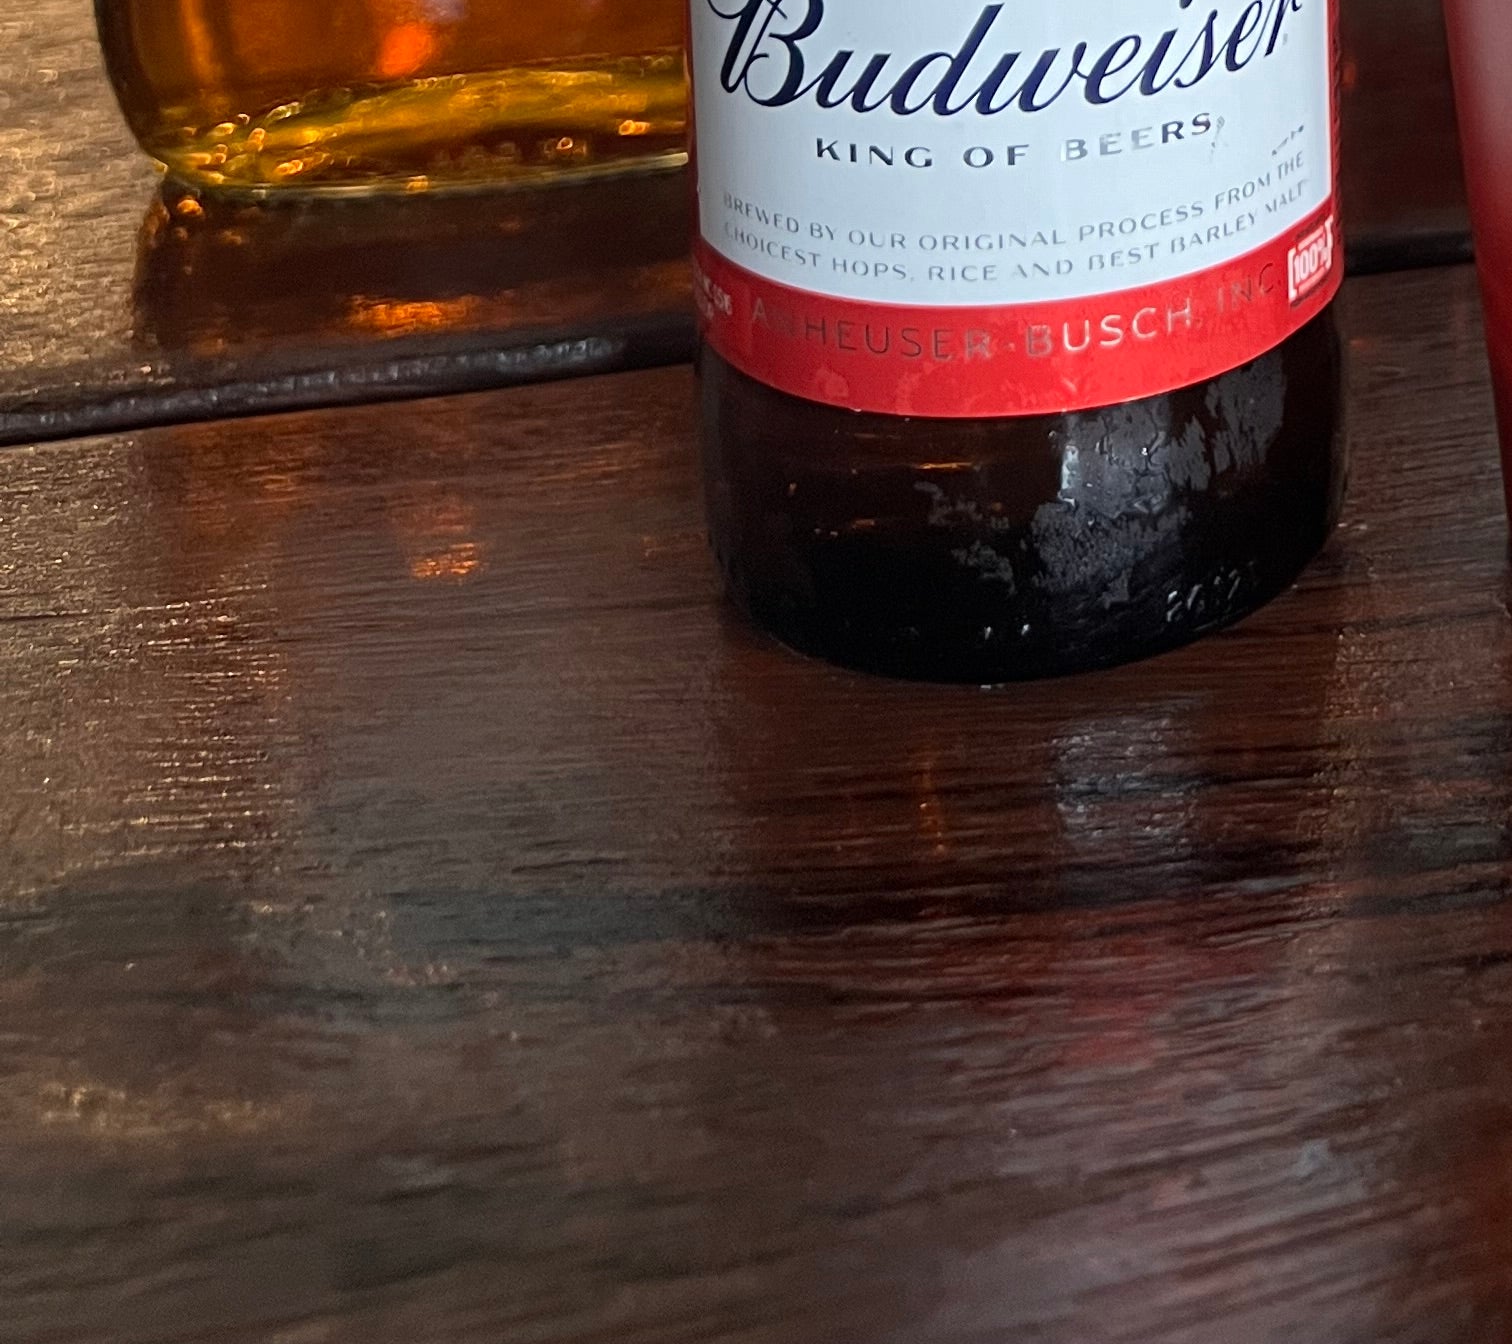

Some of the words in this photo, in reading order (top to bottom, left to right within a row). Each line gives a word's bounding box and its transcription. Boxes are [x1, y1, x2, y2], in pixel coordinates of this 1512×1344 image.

[722, 192, 799, 233] BREWED
[809, 222, 837, 241] BY
[849, 229, 906, 250] OUR
[918, 230, 1066, 251] ORIGINAL
[1079, 200, 1204, 242] PROCESS
[1215, 172, 1271, 211] FROM
[1277, 150, 1305, 180] THE
[816, 137, 933, 168] KING
[963, 144, 1030, 168] OF
[723, 221, 821, 268] CHOICEST
[928, 264, 998, 282] RICE
[1012, 258, 1074, 280] AND
[1088, 242, 1159, 271] BEST
[1170, 211, 1258, 255] BARLEY
[1265, 178, 1309, 214] MALT
